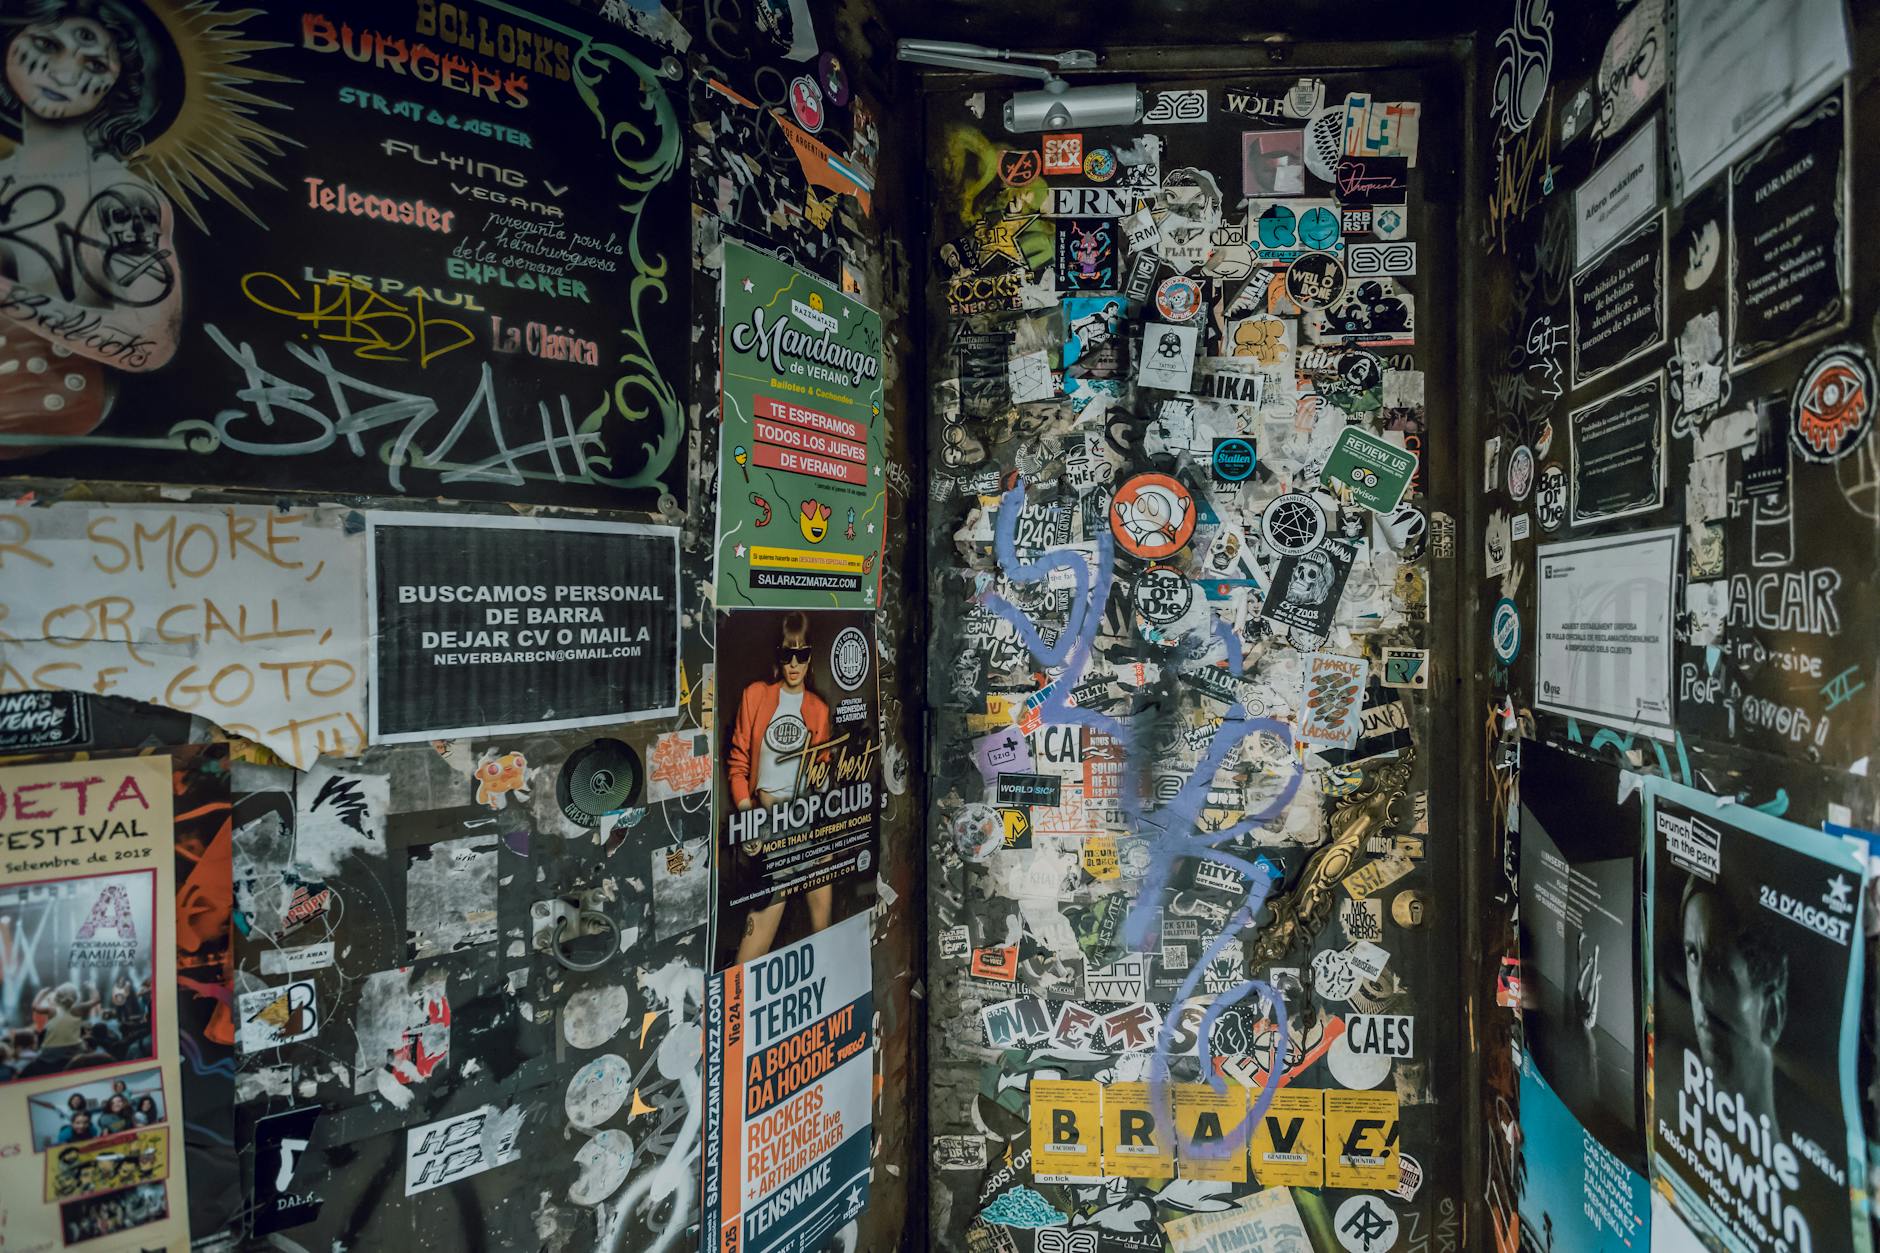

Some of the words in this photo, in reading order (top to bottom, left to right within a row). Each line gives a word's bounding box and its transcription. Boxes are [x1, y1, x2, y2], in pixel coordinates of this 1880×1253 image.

[302, 12, 530, 110] BURGERS
[339, 87, 534, 150] STRATOCASTER
[1044, 138, 1081, 154] SK8
[1044, 152, 1081, 168] DLX
[381, 139, 528, 188] FLYING
[543, 179, 569, 197] V
[1754, 152, 1817, 204] HORARIOS
[304, 178, 456, 234] Telecaster
[450, 182, 565, 219] VEGANA
[1343, 212, 1371, 222] ZRB
[1585, 196, 1608, 222] Aforo
[1343, 221, 1371, 232] RST
[380, 275, 486, 313] PAUL
[445, 257, 591, 304] EXPLORER
[1292, 268, 1320, 284] WELL
[1583, 270, 1618, 305] Prohibida
[1626, 254, 1650, 273] venta
[949, 298, 1006, 319] ENERGY
[1595, 299, 1604, 311] de
[1604, 280, 1635, 306] bebidas
[794, 304, 836, 330] RAZZMATAZZ
[1581, 326, 1612, 351] menores
[1612, 319, 1623, 331] de
[1631, 301, 1652, 321] años
[491, 315, 522, 352] La
[524, 320, 600, 368] Clásica
[731, 306, 879, 389] Mandanga
[790, 361, 804, 375] de
[806, 364, 849, 387] VERANO
[769, 402, 786, 419] TE
[789, 406, 856, 437] ESPERAMOS
[757, 423, 801, 446] TODOS
[803, 434, 826, 452] LOS
[828, 441, 866, 461] JUEVES
[1345, 436, 1391, 463] REVIEW
[1391, 457, 1408, 472] US
[780, 452, 797, 469] DE
[800, 457, 848, 479] VERANO!
[1539, 503, 1564, 524] Die
[1543, 489, 1560, 504] or
[86, 506, 326, 590] SMORE,
[398, 584, 547, 604] BUSCAMOS
[554, 585, 665, 602] PERSONAL
[757, 573, 857, 589] SALARAZZMATAZZ.COM
[486, 608, 519, 626] DE
[526, 606, 604, 625] BARRA
[1141, 597, 1182, 615] Die
[421, 631, 510, 649] DEJAR
[517, 629, 550, 647] CV
[556, 628, 573, 646] O
[579, 627, 632, 645] MAIL
[635, 626, 650, 642] A
[433, 645, 642, 666] NEVERBARBCN@GMAIL.COM
[843, 665, 859, 675] ZUTZ
[778, 724, 798, 736] OTTO
[836, 738, 883, 783] best
[563, 802, 591, 827] GREEN
[728, 807, 768, 846] HIP
[772, 794, 822, 834] HOP
[824, 782, 873, 819] CLUB
[1658, 813, 1690, 840] brunch
[762, 838, 786, 853] MORE
[787, 832, 808, 847] THAN
[808, 830, 814, 839] 4
[814, 820, 847, 839] DIFFERENT
[848, 813, 872, 828] ROOMS
[5, 856, 81, 873] Setembre
[87, 852, 108, 864] de
[114, 848, 152, 860] 2018
[1671, 836, 1680, 850] in
[1680, 840, 1696, 857] the
[1696, 847, 1718, 870] park
[1351, 901, 1367, 914] MIS
[1759, 885, 1777, 908] 26
[1779, 893, 1851, 941] D'AGOST
[69, 948, 136, 961] FAMILIAR
[749, 942, 815, 1002] TODD
[729, 1002, 741, 1023] 24
[749, 976, 826, 1047] TERRY
[728, 1023, 741, 1047] Vie
[748, 1055, 763, 1086] A
[766, 1020, 826, 1079] BOOGIE
[827, 1004, 855, 1041] WIT
[1346, 1016, 1411, 1056] CAES
[706, 976, 721, 1208] SALARAZZMATAZZ.COM
[747, 1078, 775, 1117] DA
[777, 1041, 836, 1100] HOODIE
[747, 1083, 824, 1153] ROCKERS
[1683, 1046, 1800, 1192] Richie
[747, 1111, 822, 1183] REVENGE
[823, 1110, 841, 1130] live
[758, 1152, 807, 1199] ARTHUR
[808, 1123, 844, 1163] BAKER
[1658, 1118, 1687, 1160] Fabio
[1687, 1148, 1730, 1206] Florido
[1055, 1174, 1070, 1182] tick
[1583, 1137, 1600, 1165] CAB
[1599, 1154, 1633, 1200] DRIVERS
[1583, 1154, 1599, 1179] ION
[1599, 1168, 1633, 1219] LUDWIG
[1677, 1088, 1813, 1253] Hawtin
[746, 1157, 832, 1241] TENSNAKE
[1583, 1169, 1609, 1206] JULIAN
[1608, 1194, 1636, 1237] PEREZ
[725, 1225, 738, 1243] 25
